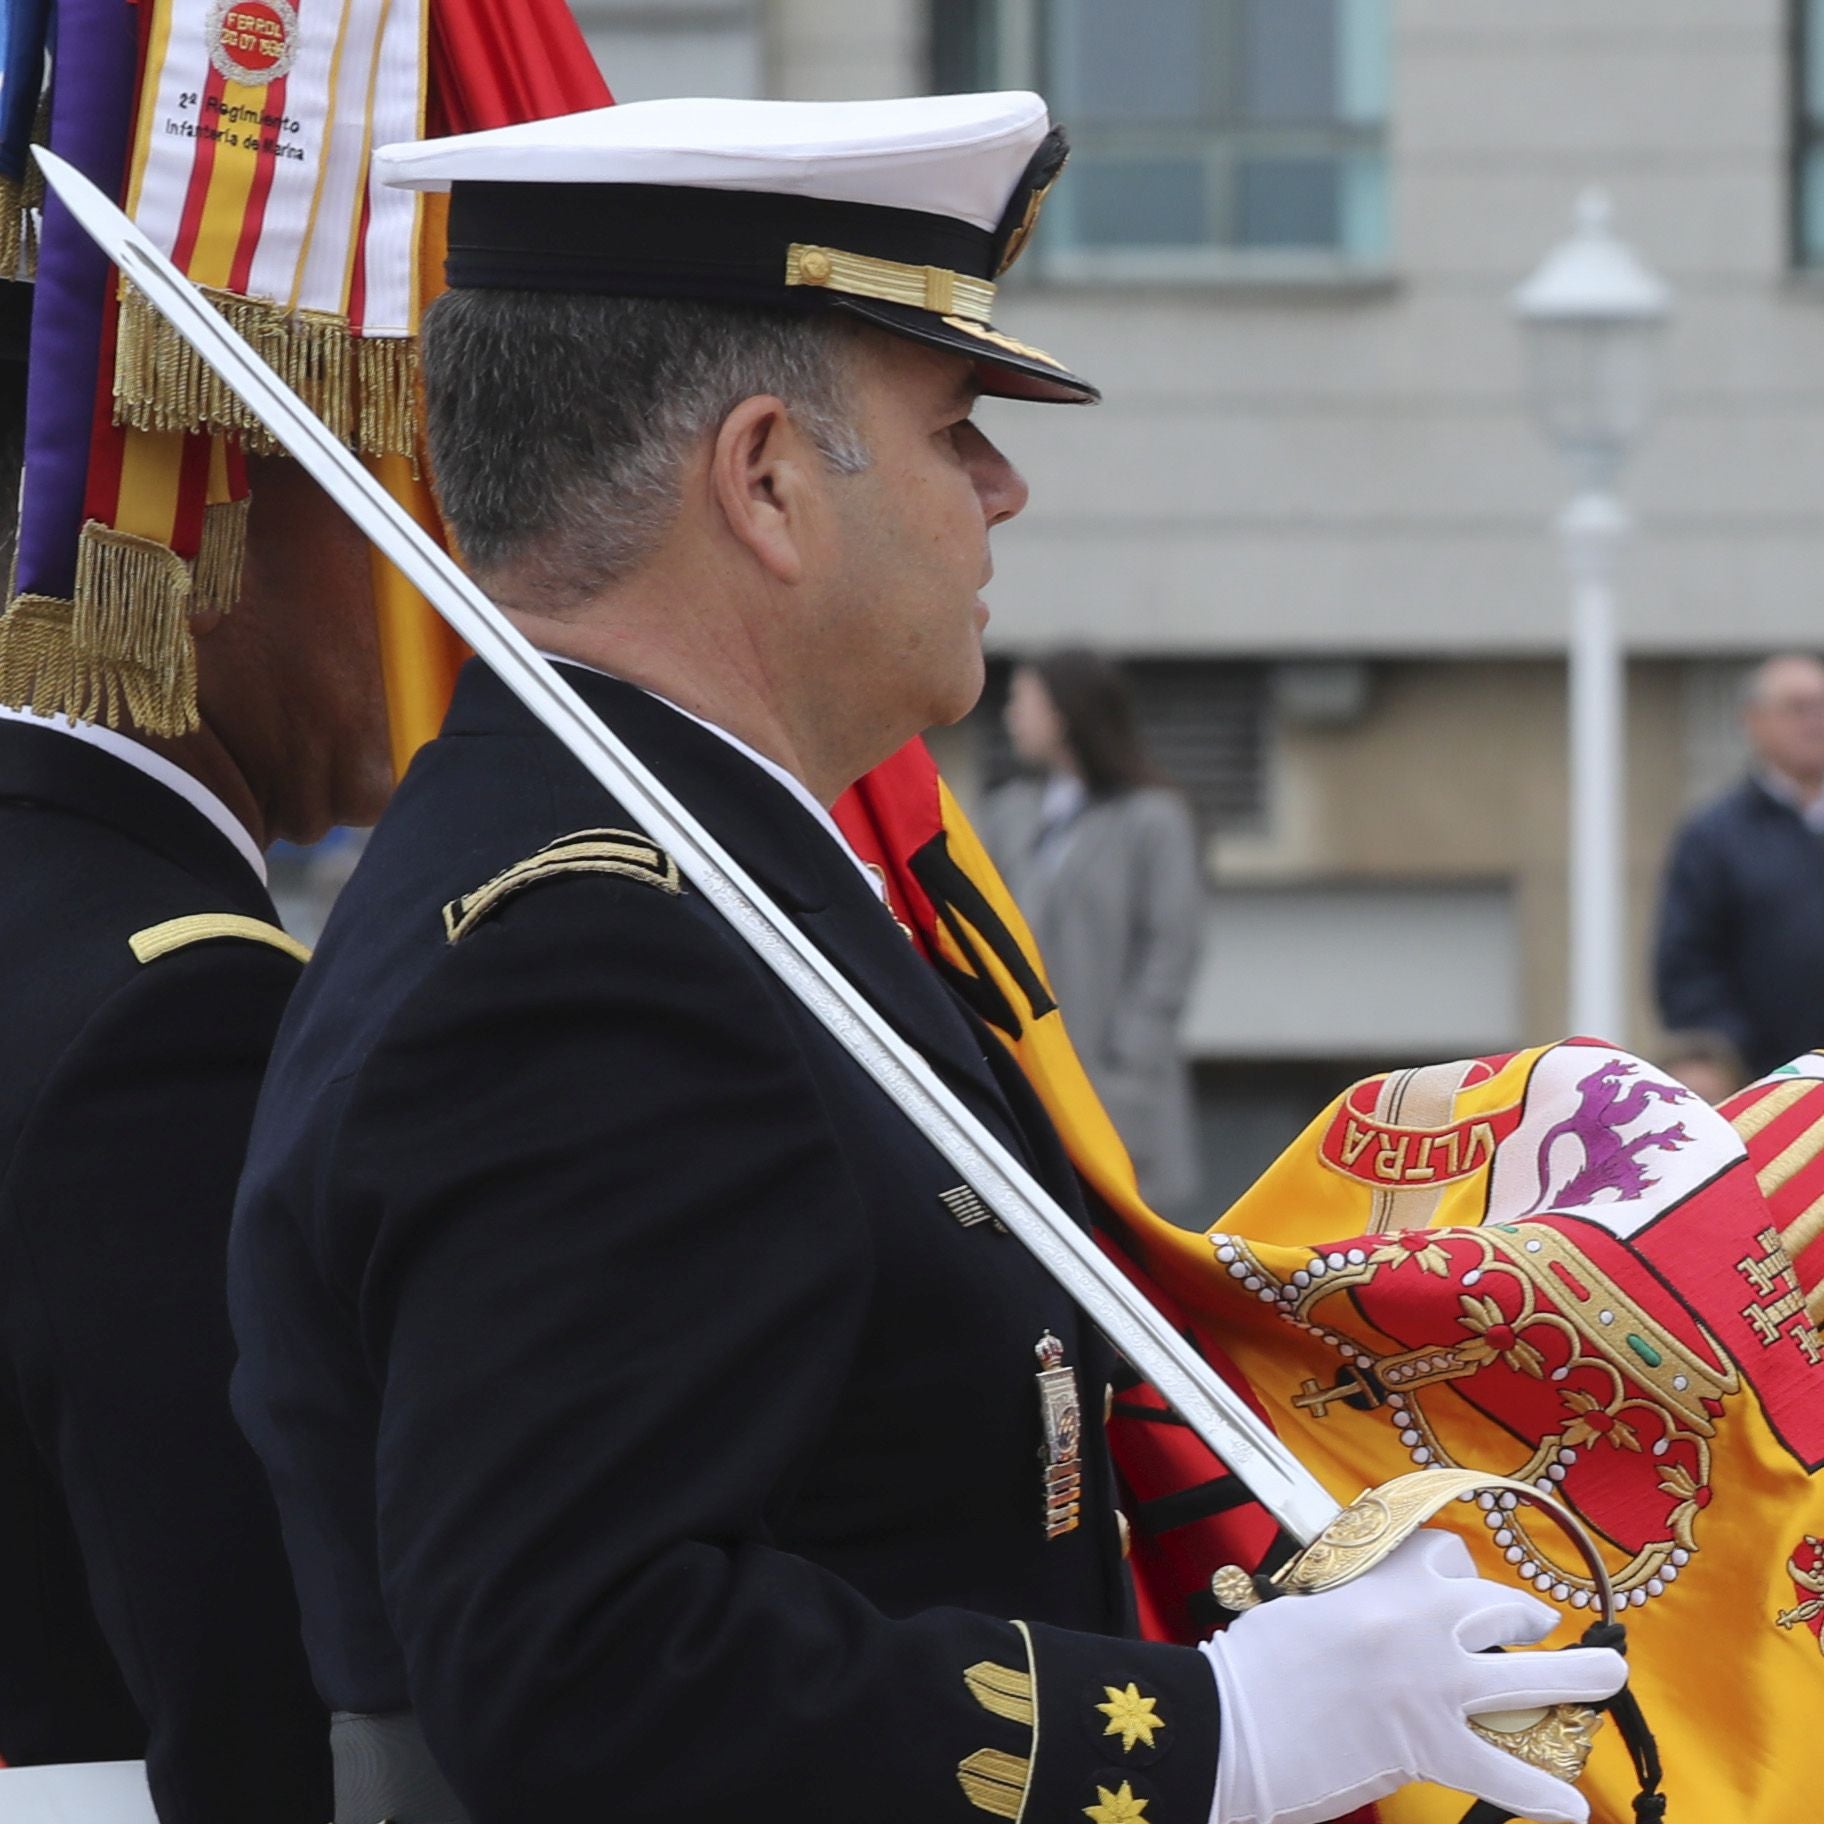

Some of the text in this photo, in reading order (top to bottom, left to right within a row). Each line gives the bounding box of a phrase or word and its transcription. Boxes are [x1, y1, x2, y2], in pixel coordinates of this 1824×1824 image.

[226, 12, 283, 38] FERROL
[206, 96, 300, 133] Regimiento
[243, 135, 259, 151] de
[262, 138, 304, 161] Marina
[1340, 1119, 1496, 1181] VLTRA
